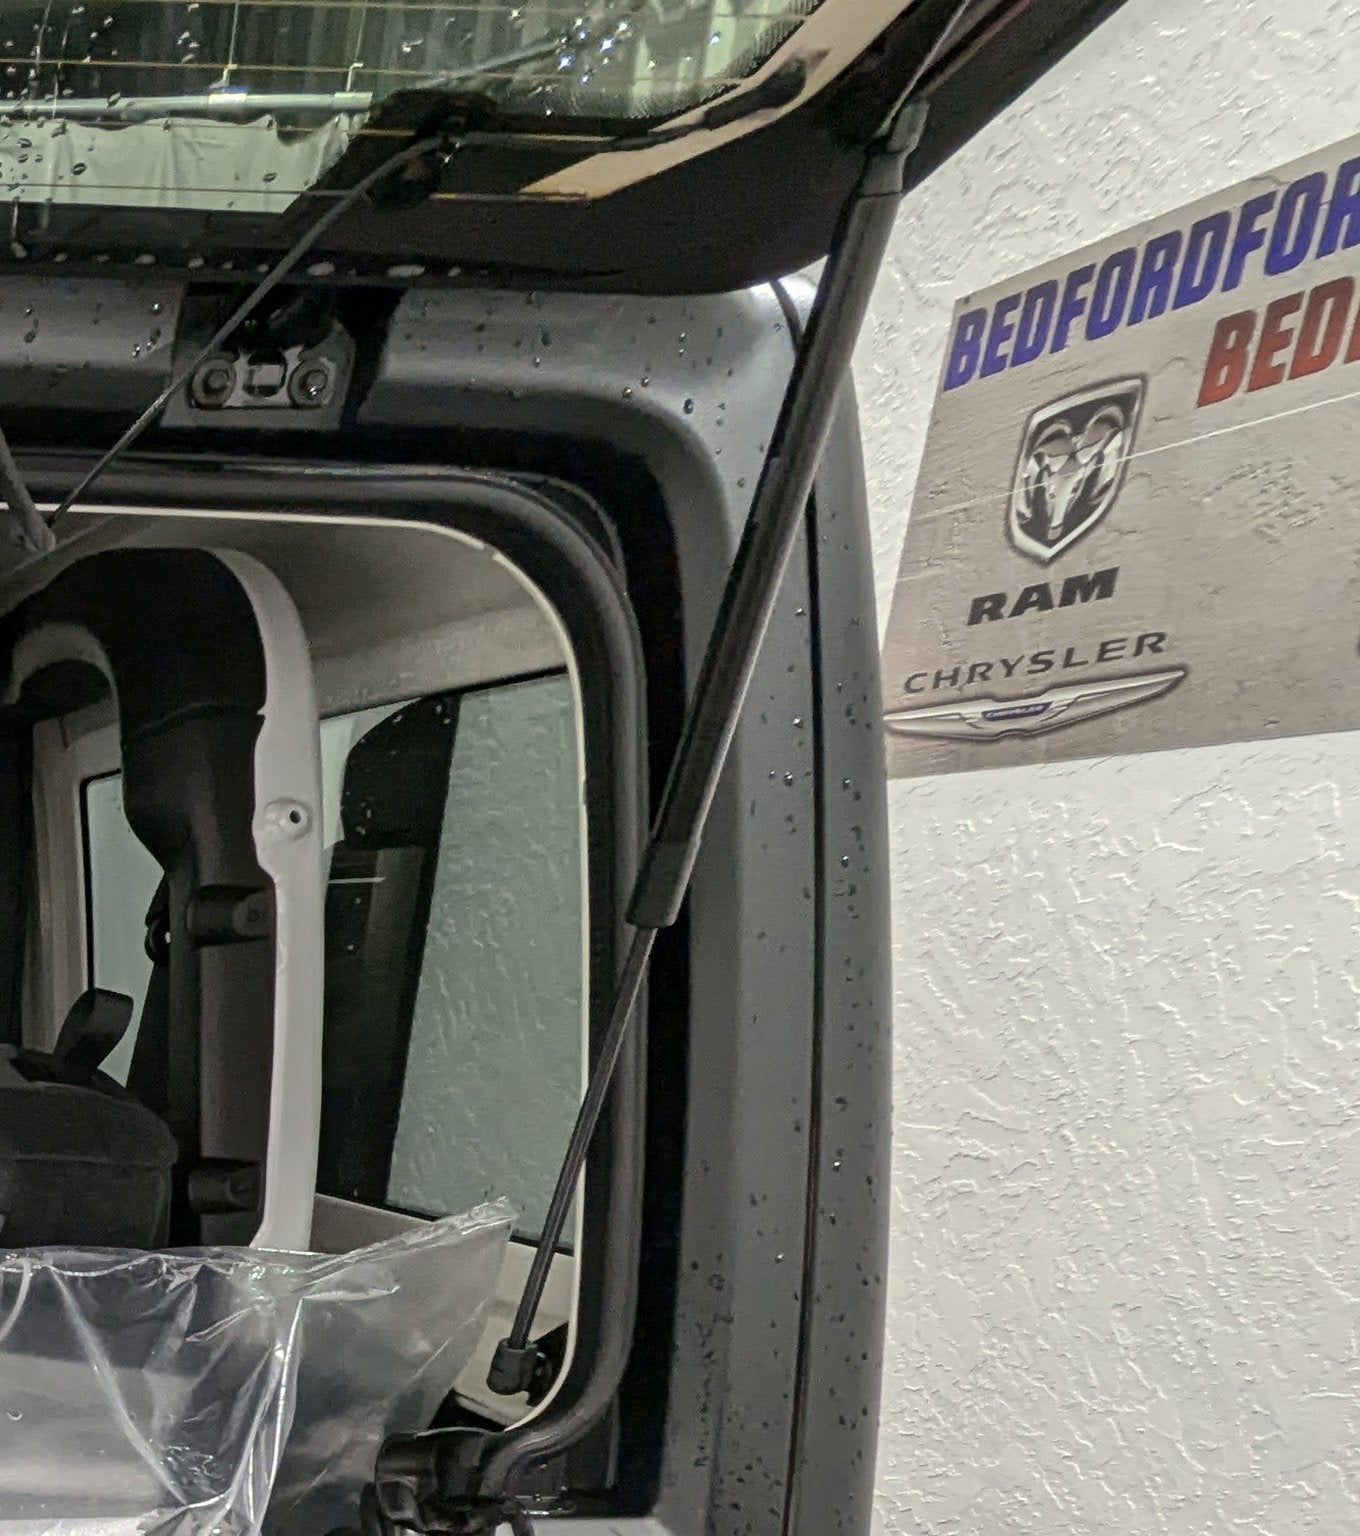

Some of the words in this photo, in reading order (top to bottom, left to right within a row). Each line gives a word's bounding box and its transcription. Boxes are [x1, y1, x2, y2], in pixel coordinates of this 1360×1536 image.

[1195, 275, 1360, 408] BED
[966, 566, 1120, 626] RAM
[903, 630, 1167, 696] CHRYSLER
